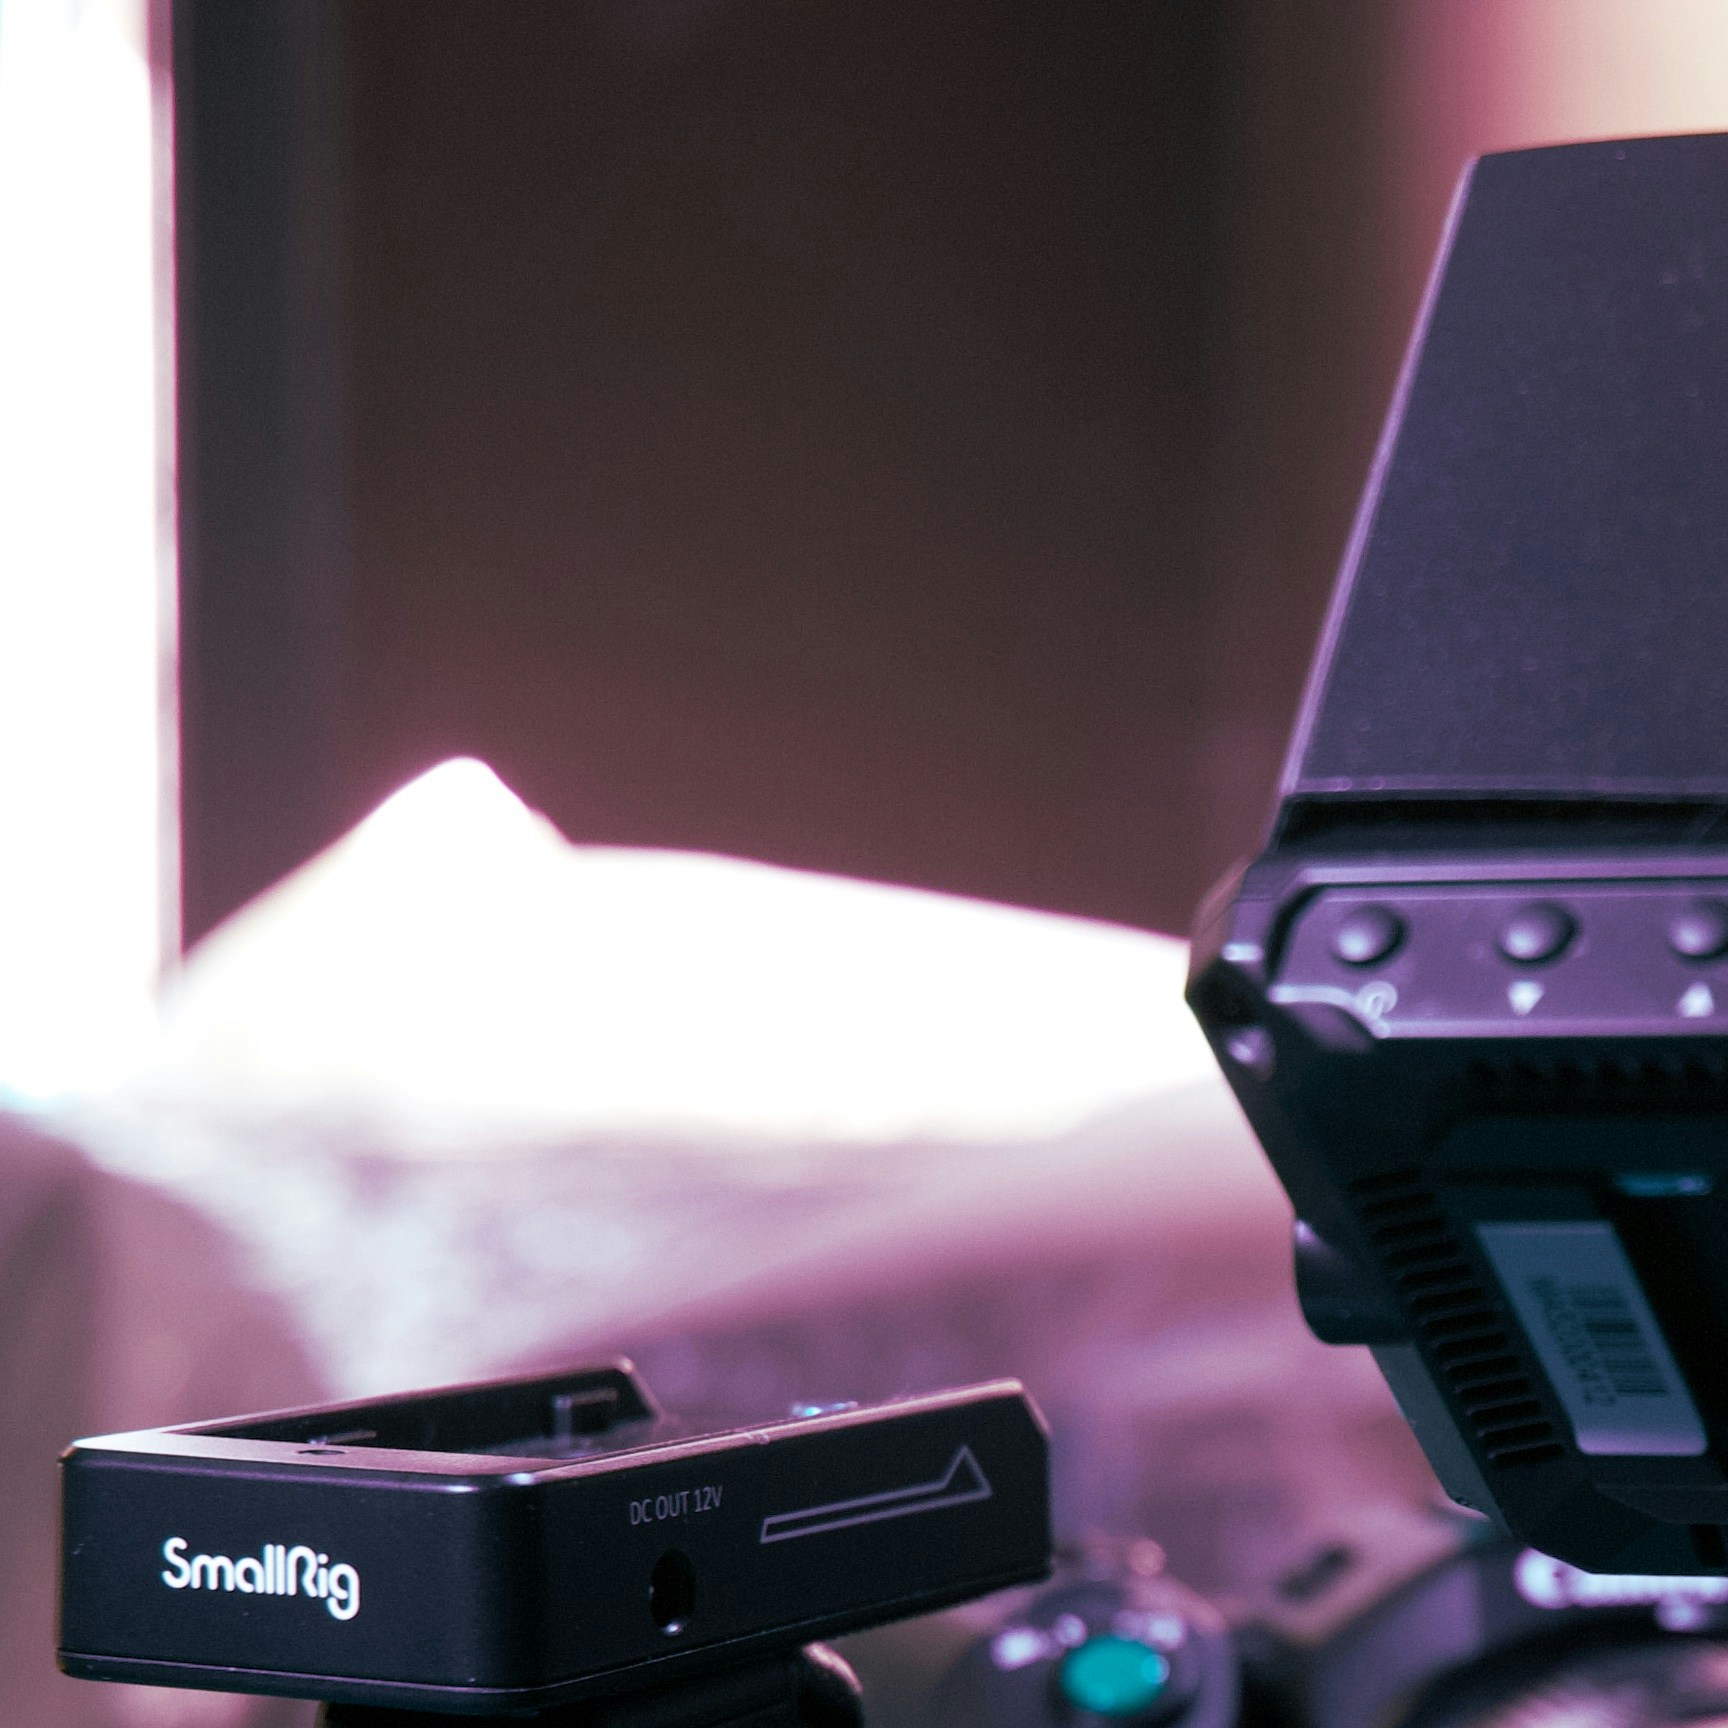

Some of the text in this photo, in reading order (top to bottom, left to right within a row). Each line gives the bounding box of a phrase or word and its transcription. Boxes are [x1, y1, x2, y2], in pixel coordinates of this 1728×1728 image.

[629, 1485, 724, 1526] DC OUT 12V
[160, 1536, 360, 1621] SmallRig
